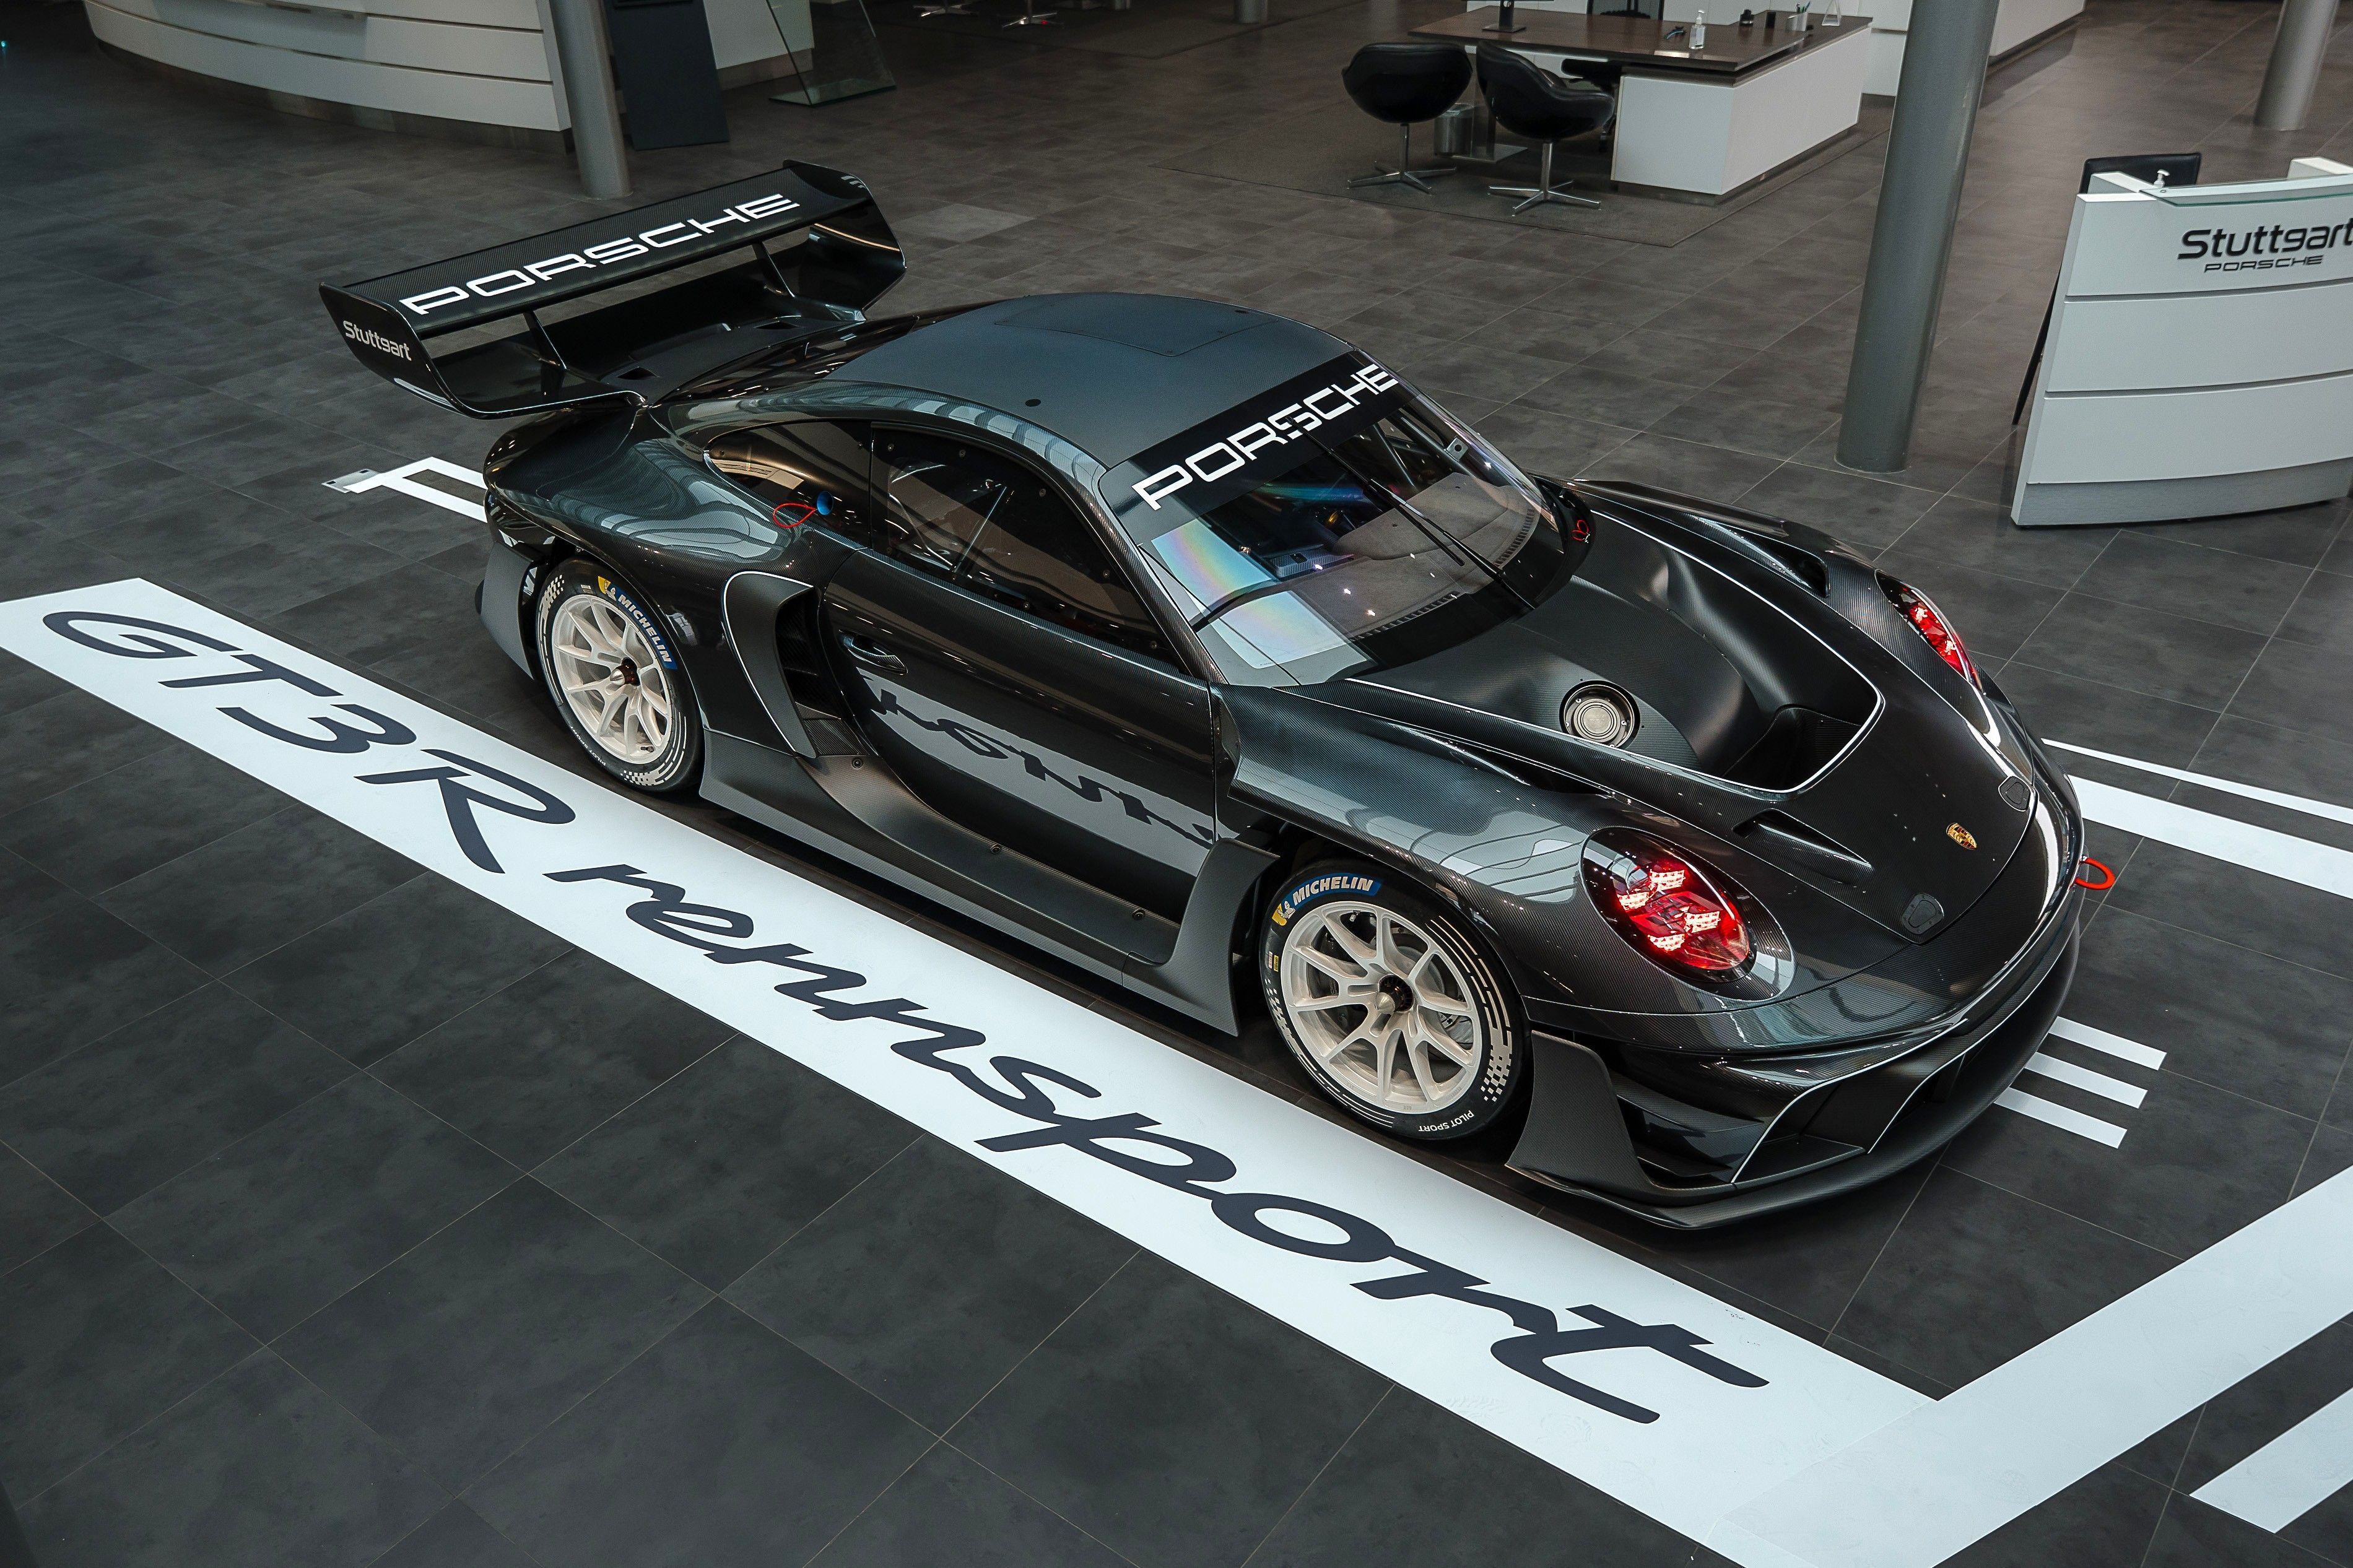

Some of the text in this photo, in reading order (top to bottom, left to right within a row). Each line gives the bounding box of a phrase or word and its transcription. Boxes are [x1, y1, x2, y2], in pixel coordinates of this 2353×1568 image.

[399, 193, 801, 315] PORSCHE
[2177, 218, 2353, 260] Stuttgart
[2203, 254, 2324, 273] PORSCHE
[343, 320, 412, 361] Stuttgart
[1131, 363, 1399, 511] PORSCHE
[617, 594, 672, 662] MICHELIN
[1292, 876, 1373, 906] MICHELIN
[1418, 1110, 1476, 1132] PILOT SPORT
[542, 864, 1770, 1424] rennsport
